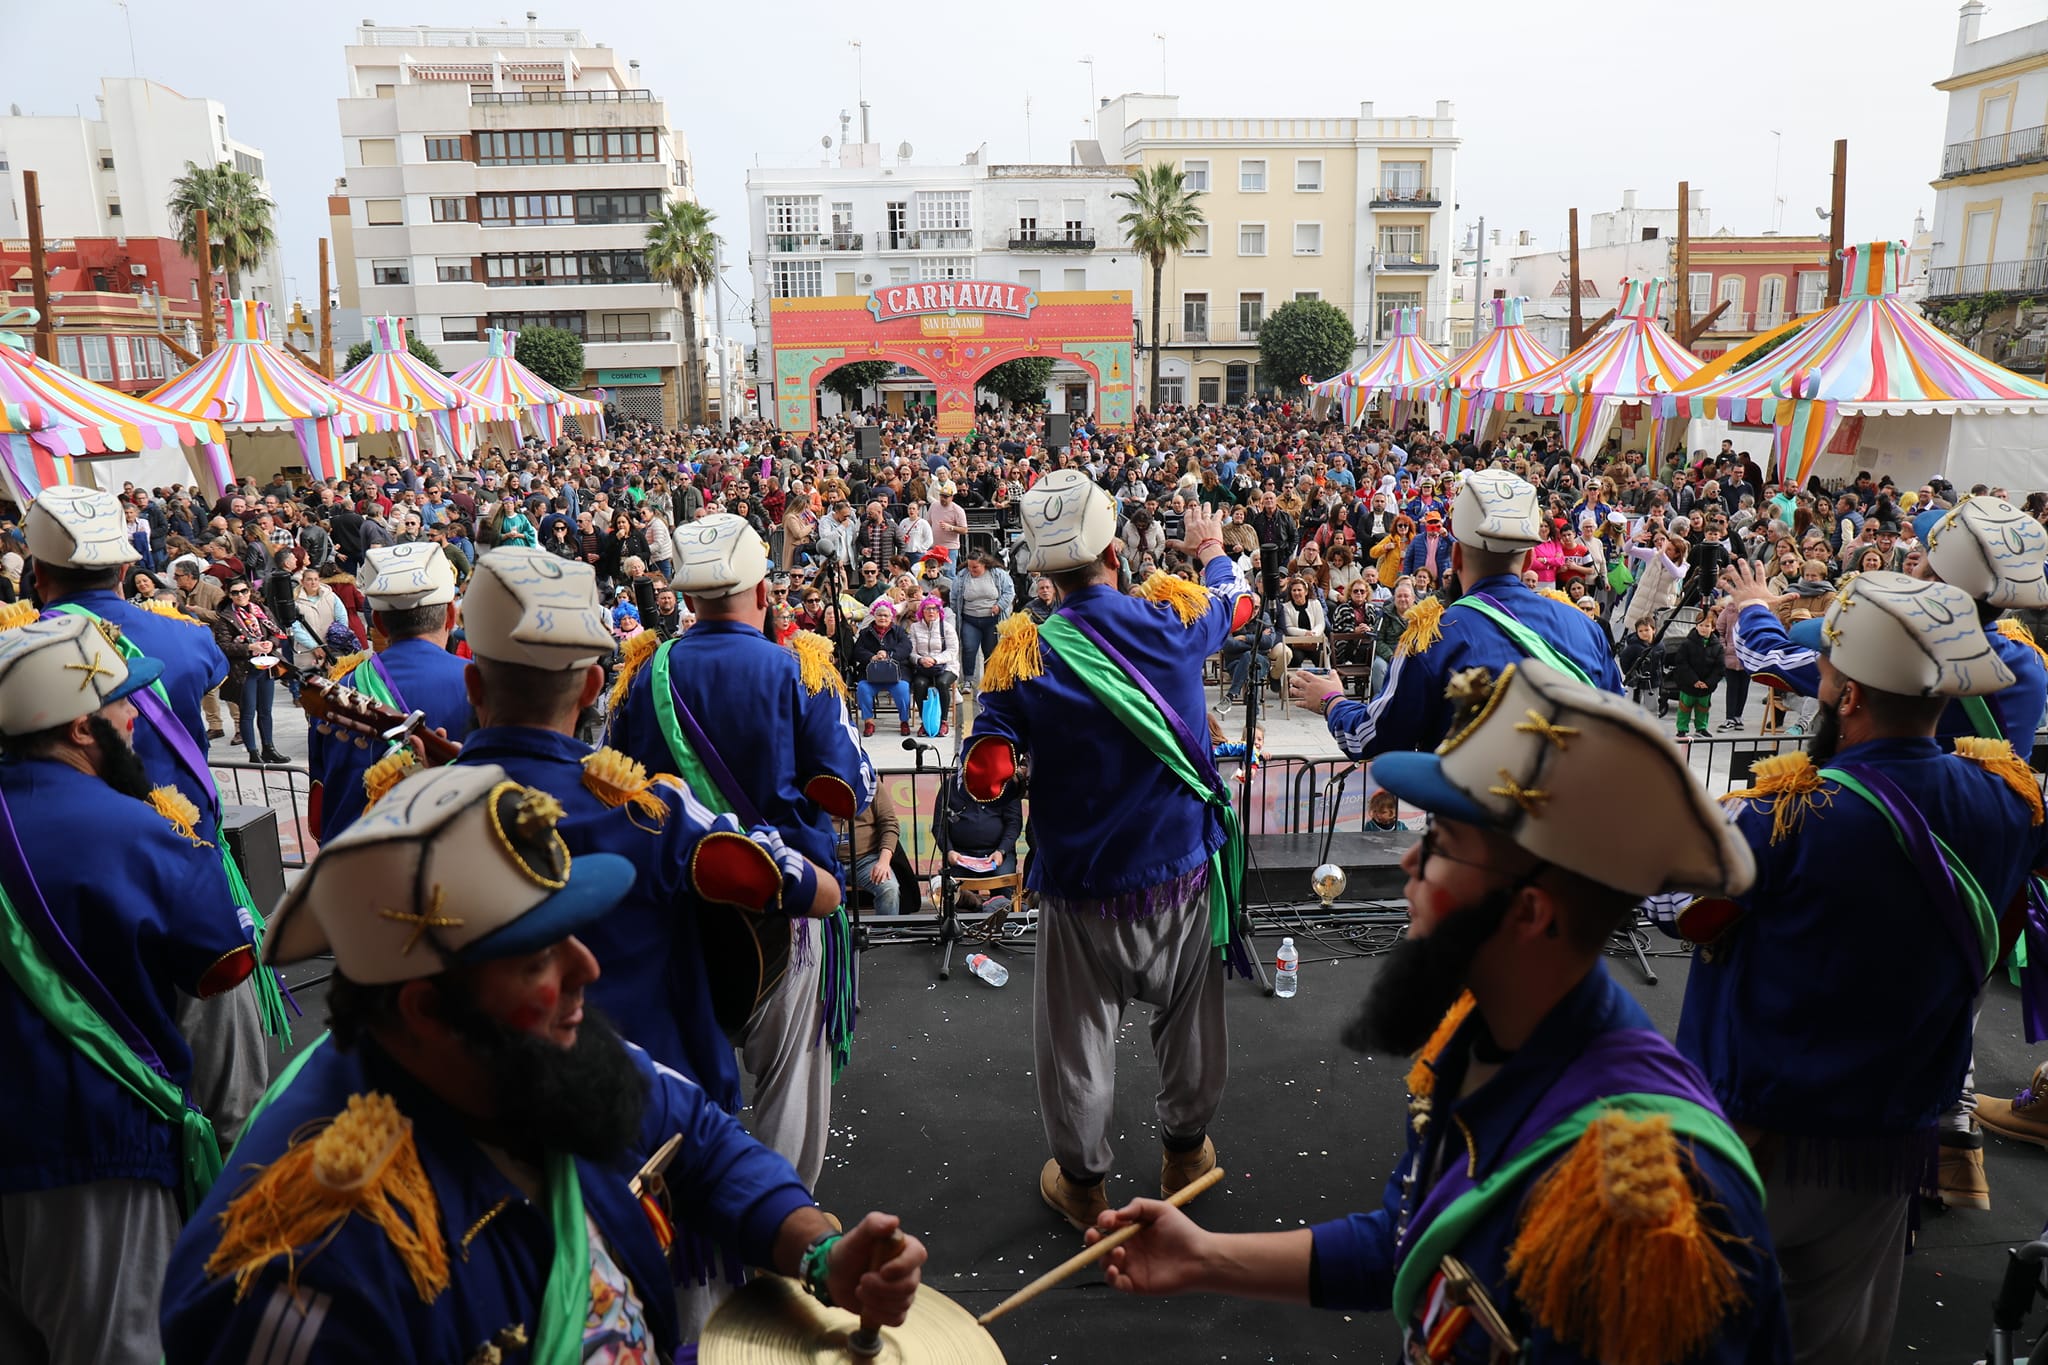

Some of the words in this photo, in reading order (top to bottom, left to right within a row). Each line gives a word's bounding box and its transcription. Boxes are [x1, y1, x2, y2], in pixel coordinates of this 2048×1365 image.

[888, 284, 1019, 313] CARNAVAL
[923, 318, 939, 330] SAN
[942, 316, 982, 329] FERNANDO
